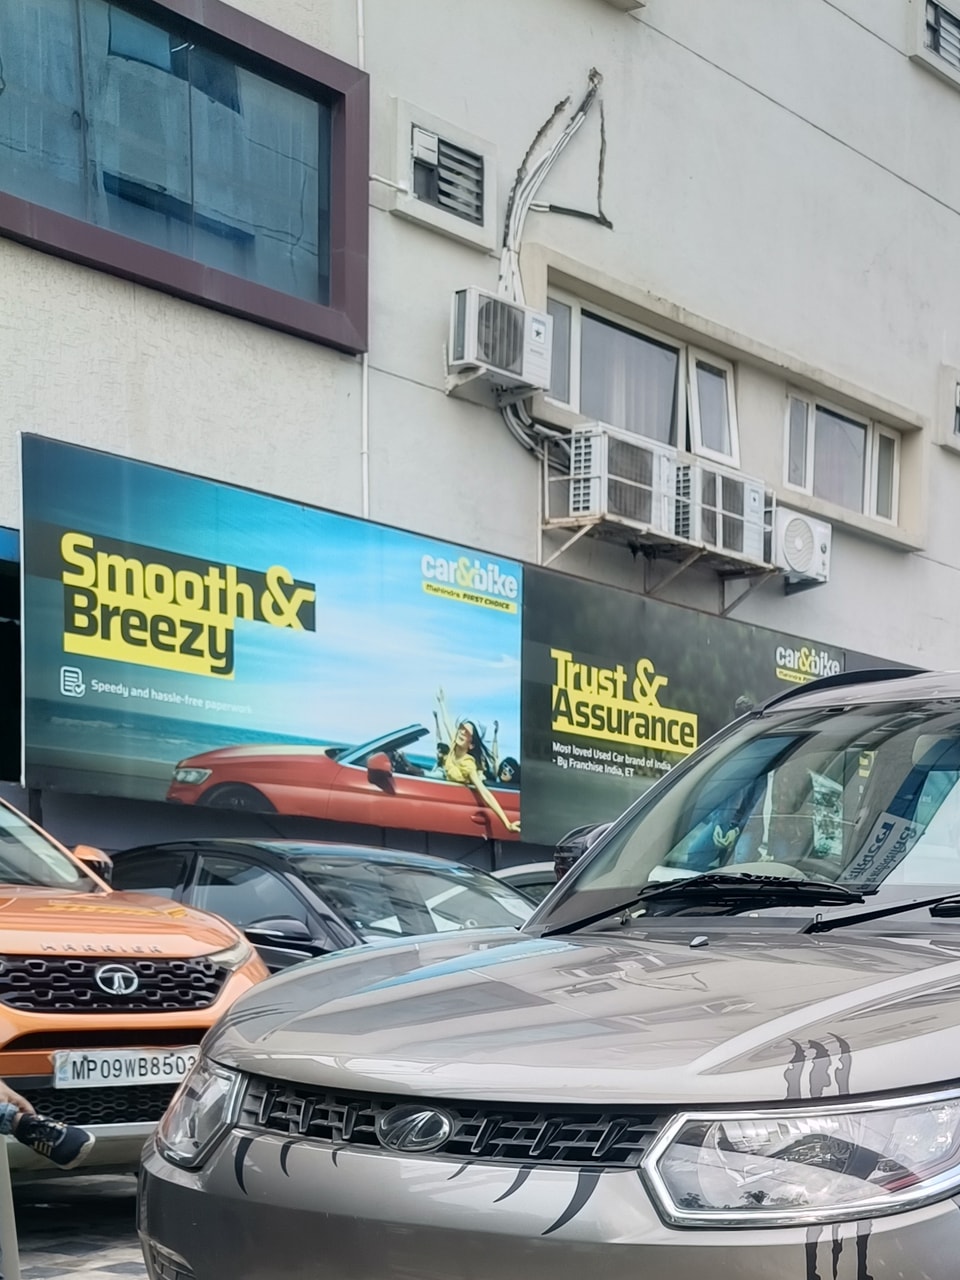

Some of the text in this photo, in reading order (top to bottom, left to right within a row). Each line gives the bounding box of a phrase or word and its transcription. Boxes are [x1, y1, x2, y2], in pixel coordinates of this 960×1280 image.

[60, 532, 315, 630] Smooth &
[421, 554, 518, 599] car&bike
[462, 593, 484, 604] FIRST
[484, 598, 510, 610] CHOICE
[63, 586, 235, 675] Breezy
[549, 647, 668, 708] Trust &
[776, 646, 840, 677] car&bike
[91, 679, 252, 714] Speedy and hassle-free paperwork
[552, 689, 695, 749] Assurance
[552, 741, 572, 754] Most
[573, 744, 592, 757] loved
[593, 749, 611, 761] Used
[612, 752, 624, 762] Car
[625, 754, 645, 767] brand
[646, 758, 653, 767] of
[557, 756, 567, 769] By
[569, 759, 603, 773] Franchise
[605, 764, 624, 777] India,
[625, 768, 634, 777] ET
